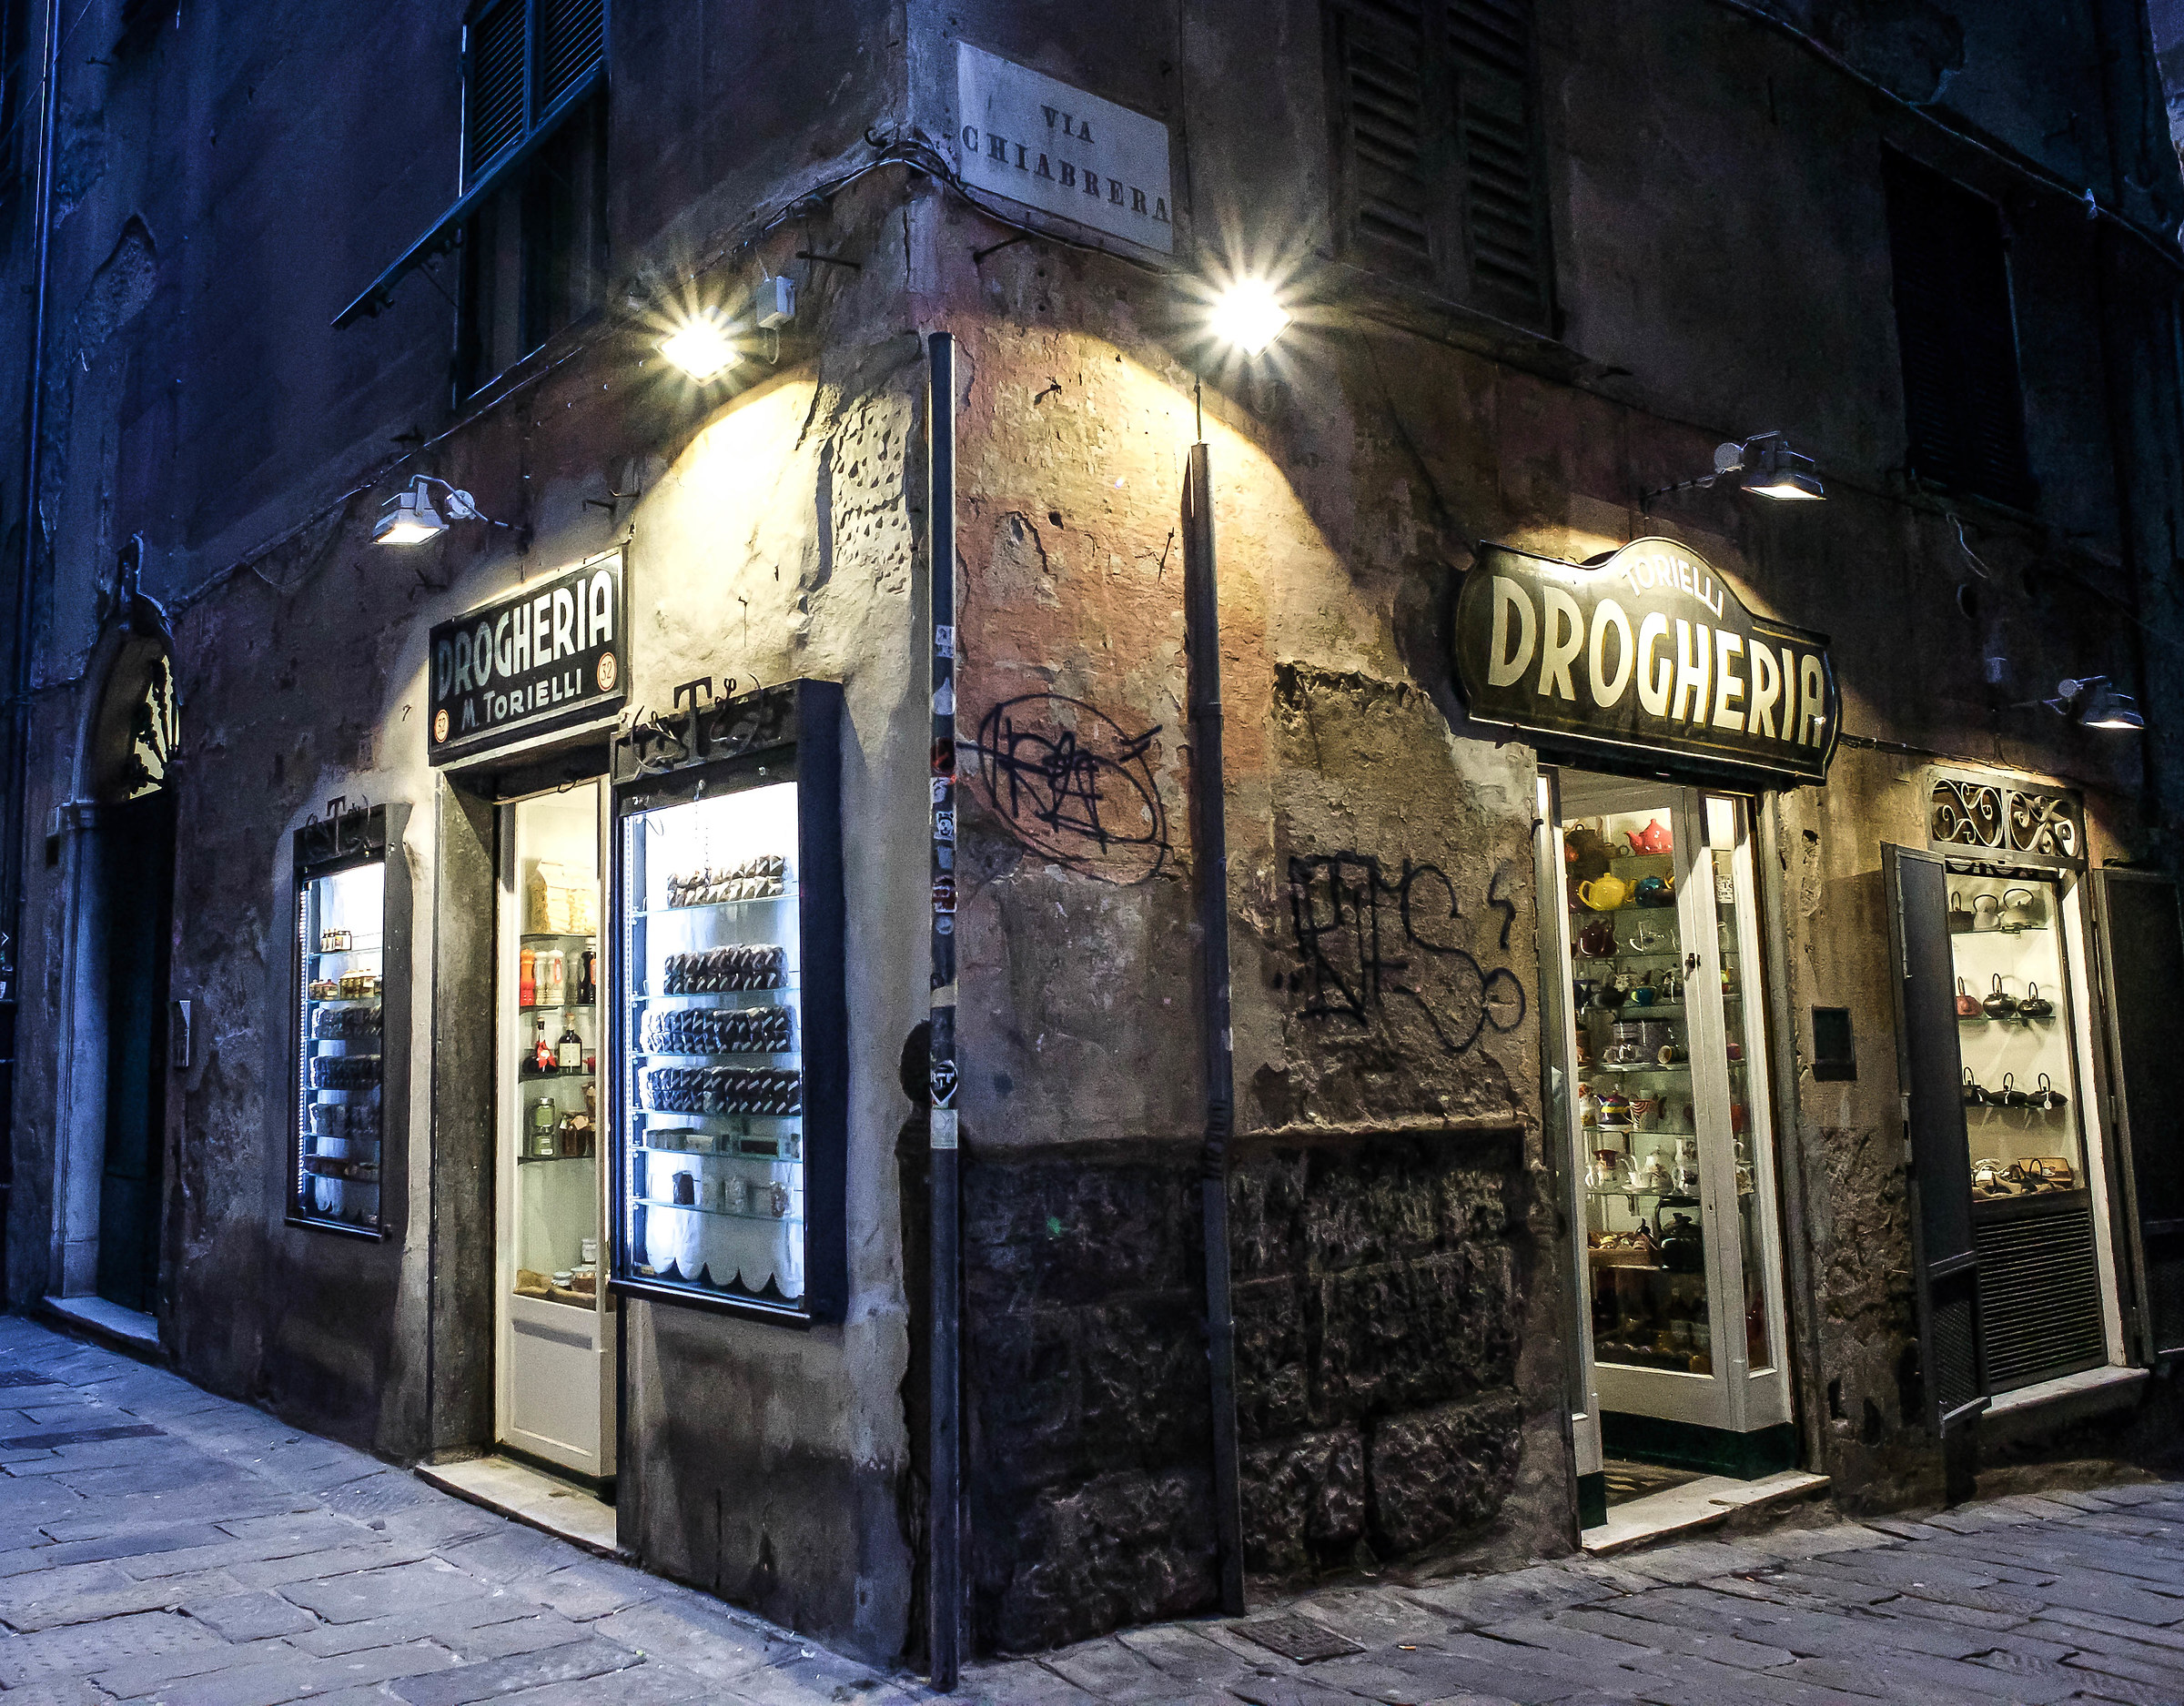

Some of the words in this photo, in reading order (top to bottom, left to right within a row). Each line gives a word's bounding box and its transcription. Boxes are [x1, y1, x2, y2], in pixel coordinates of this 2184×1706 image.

[1041, 105, 1094, 144] VIA
[962, 125, 1170, 223] CHIABRERA
[1623, 554, 1724, 621] TORIELLI
[438, 570, 612, 702] DROGHERIA
[1488, 576, 1824, 748] DROGHERIA
[483, 668, 581, 723] TORIELLI
